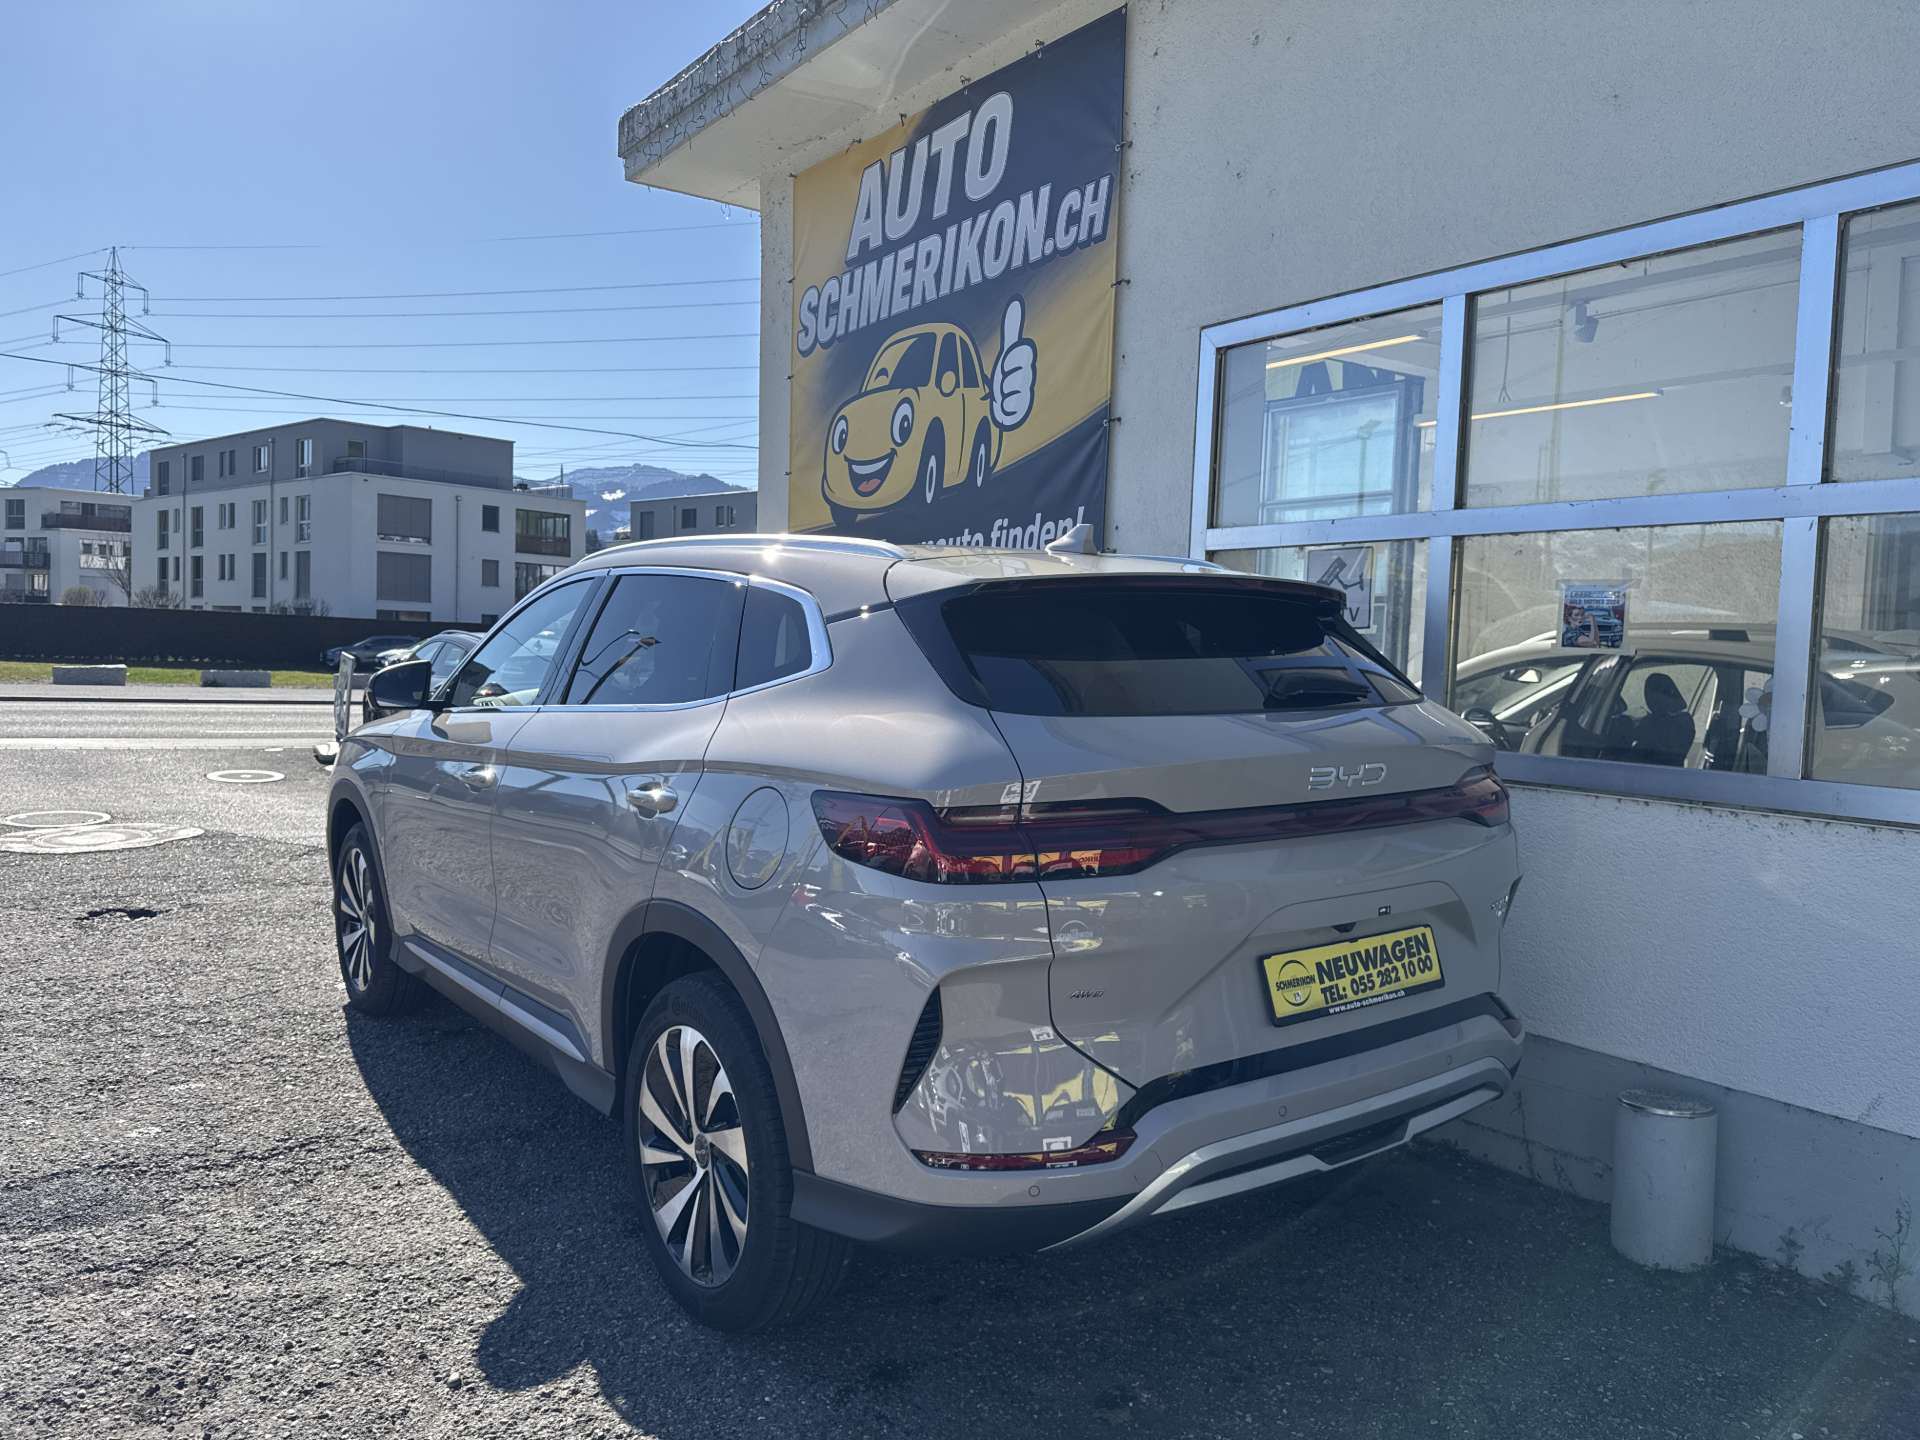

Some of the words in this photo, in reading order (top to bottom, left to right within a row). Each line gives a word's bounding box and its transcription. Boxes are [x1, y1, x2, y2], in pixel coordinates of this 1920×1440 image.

[846, 91, 1014, 264] AUTO
[798, 174, 1112, 352] SCHMERIKON.CH
[1308, 762, 1388, 790] BYD
[1275, 974, 1316, 992] SCHMERIKON
[1315, 932, 1432, 986] NEUWAGEN
[1320, 984, 1348, 1006] TEL:
[1350, 972, 1376, 997] 055
[1376, 965, 1401, 988] 282
[1402, 960, 1417, 979] 10
[1417, 954, 1433, 973] 00
[1328, 990, 1406, 1014] www.auto-schmerikon.ch
